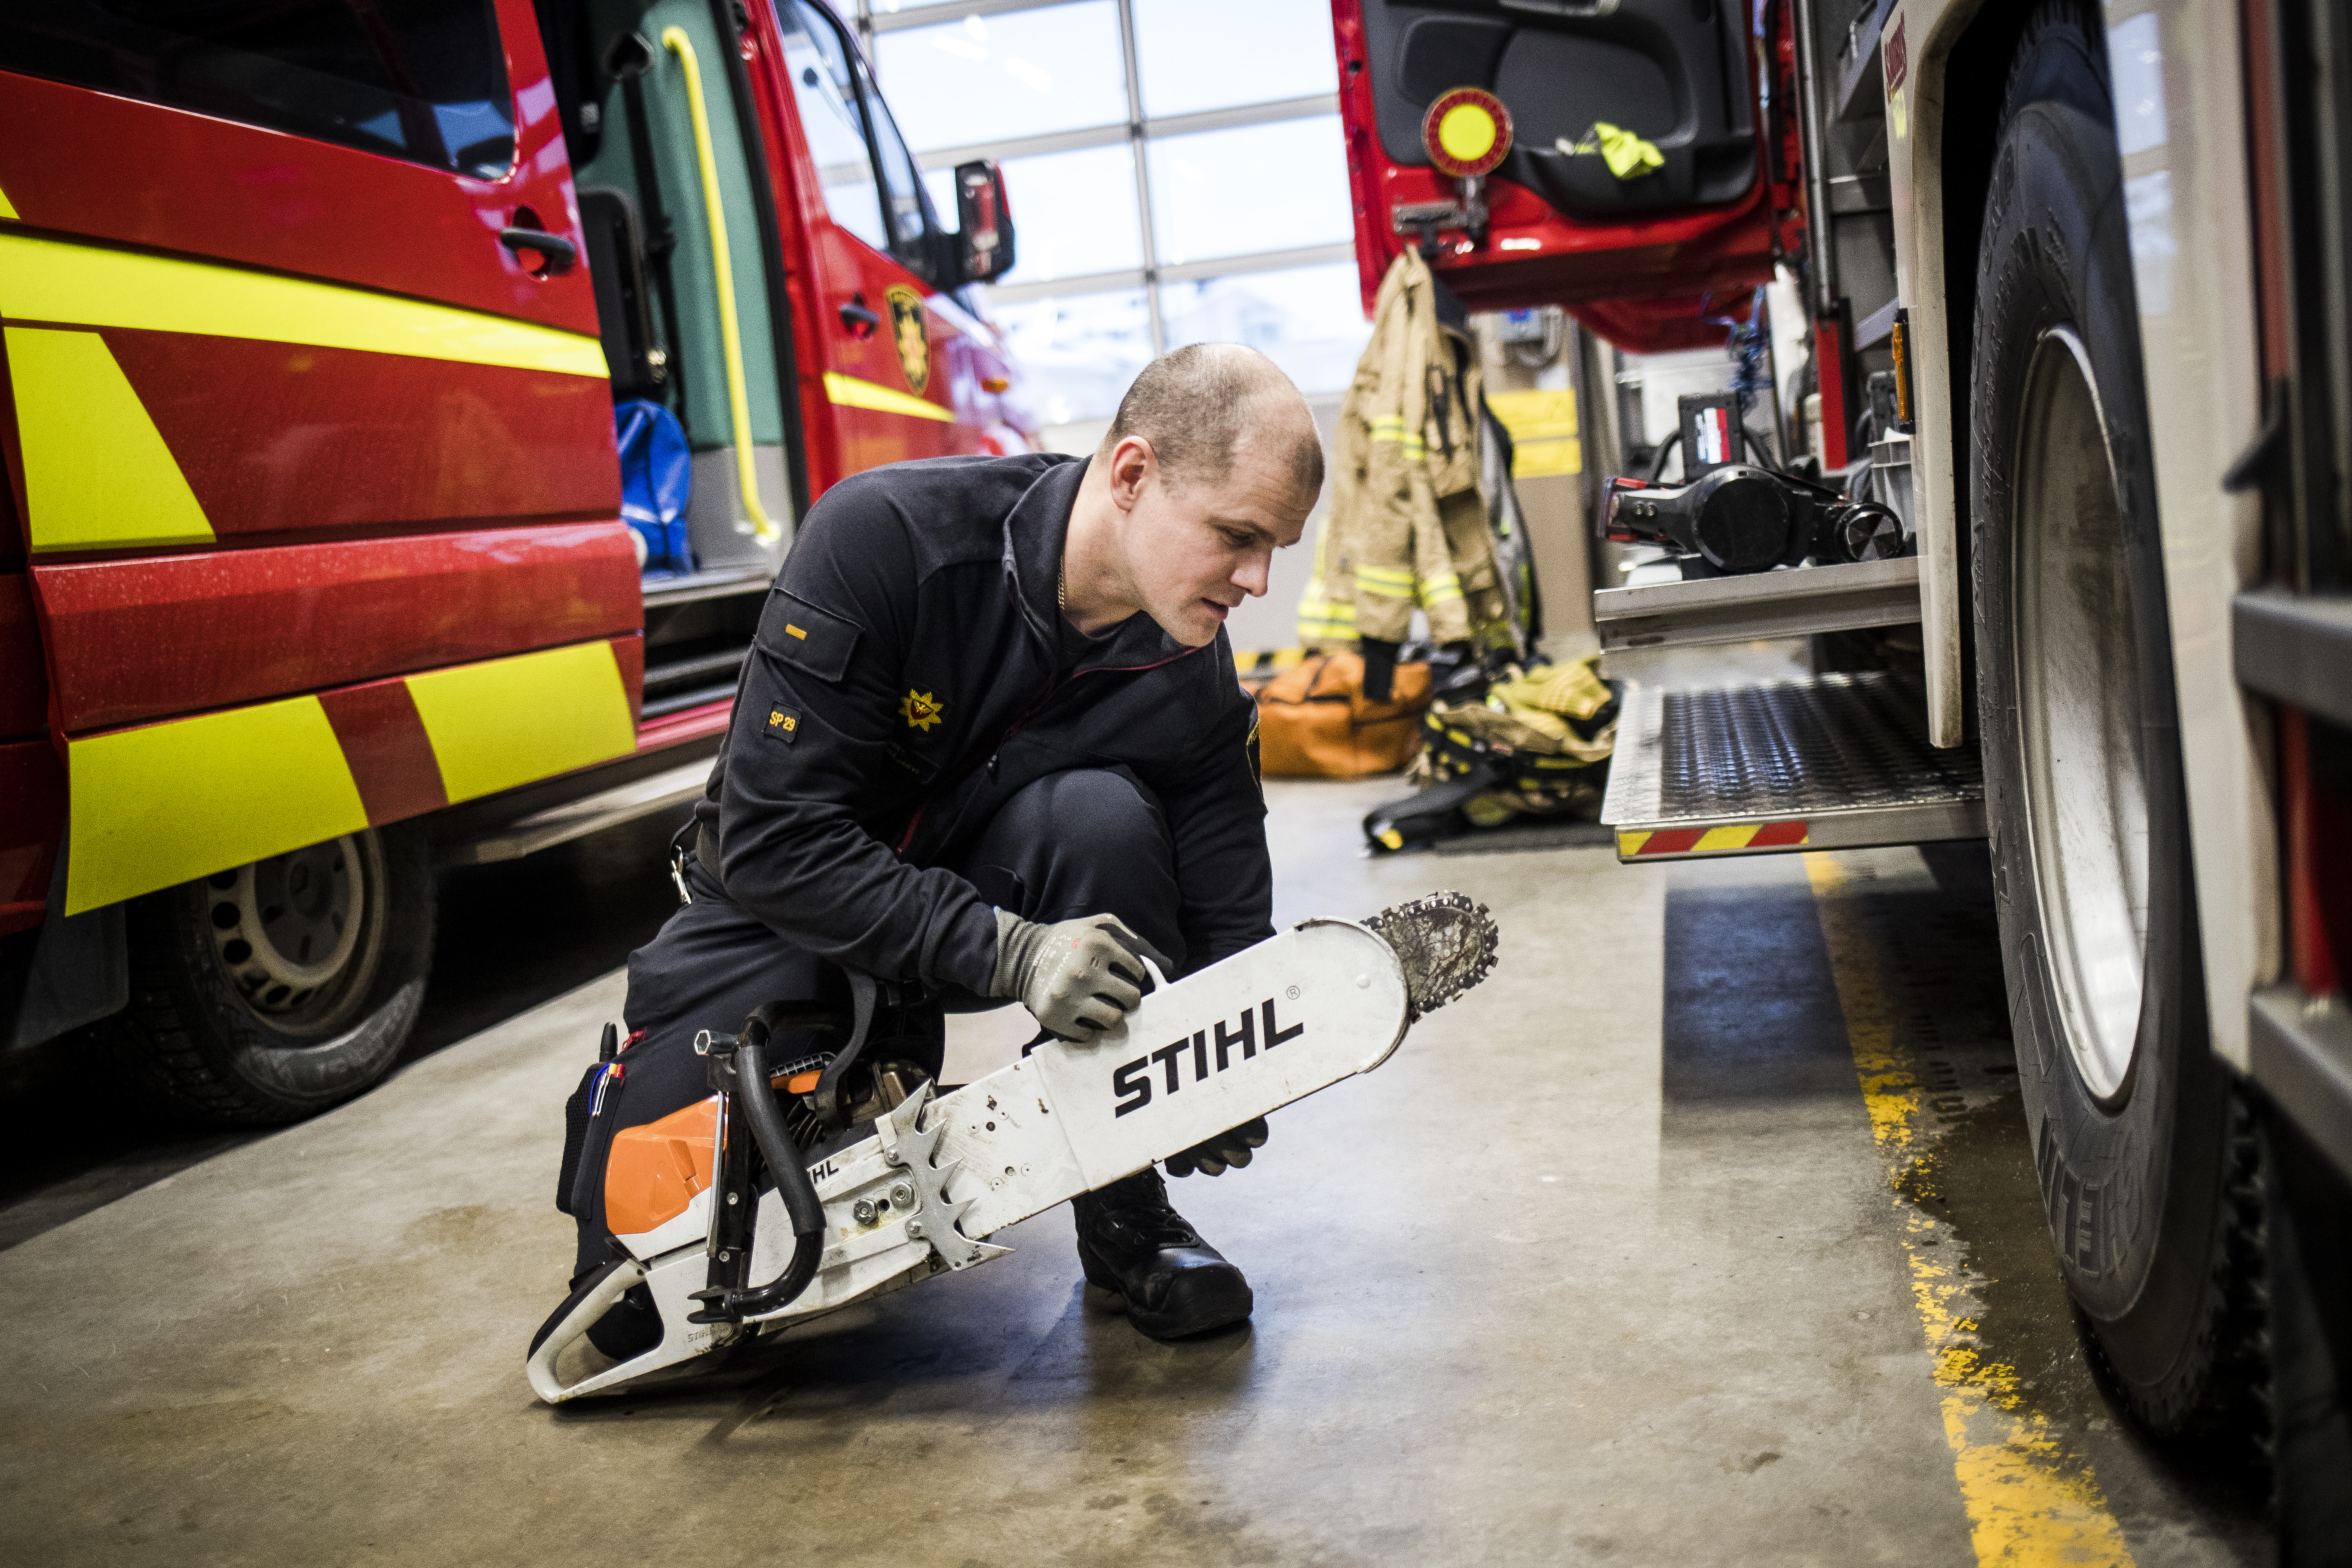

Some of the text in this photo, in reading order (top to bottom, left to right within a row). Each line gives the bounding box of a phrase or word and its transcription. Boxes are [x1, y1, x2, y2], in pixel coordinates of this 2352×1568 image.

[769, 710, 796, 732] SP 29
[1113, 998, 1304, 1118] STIHL
